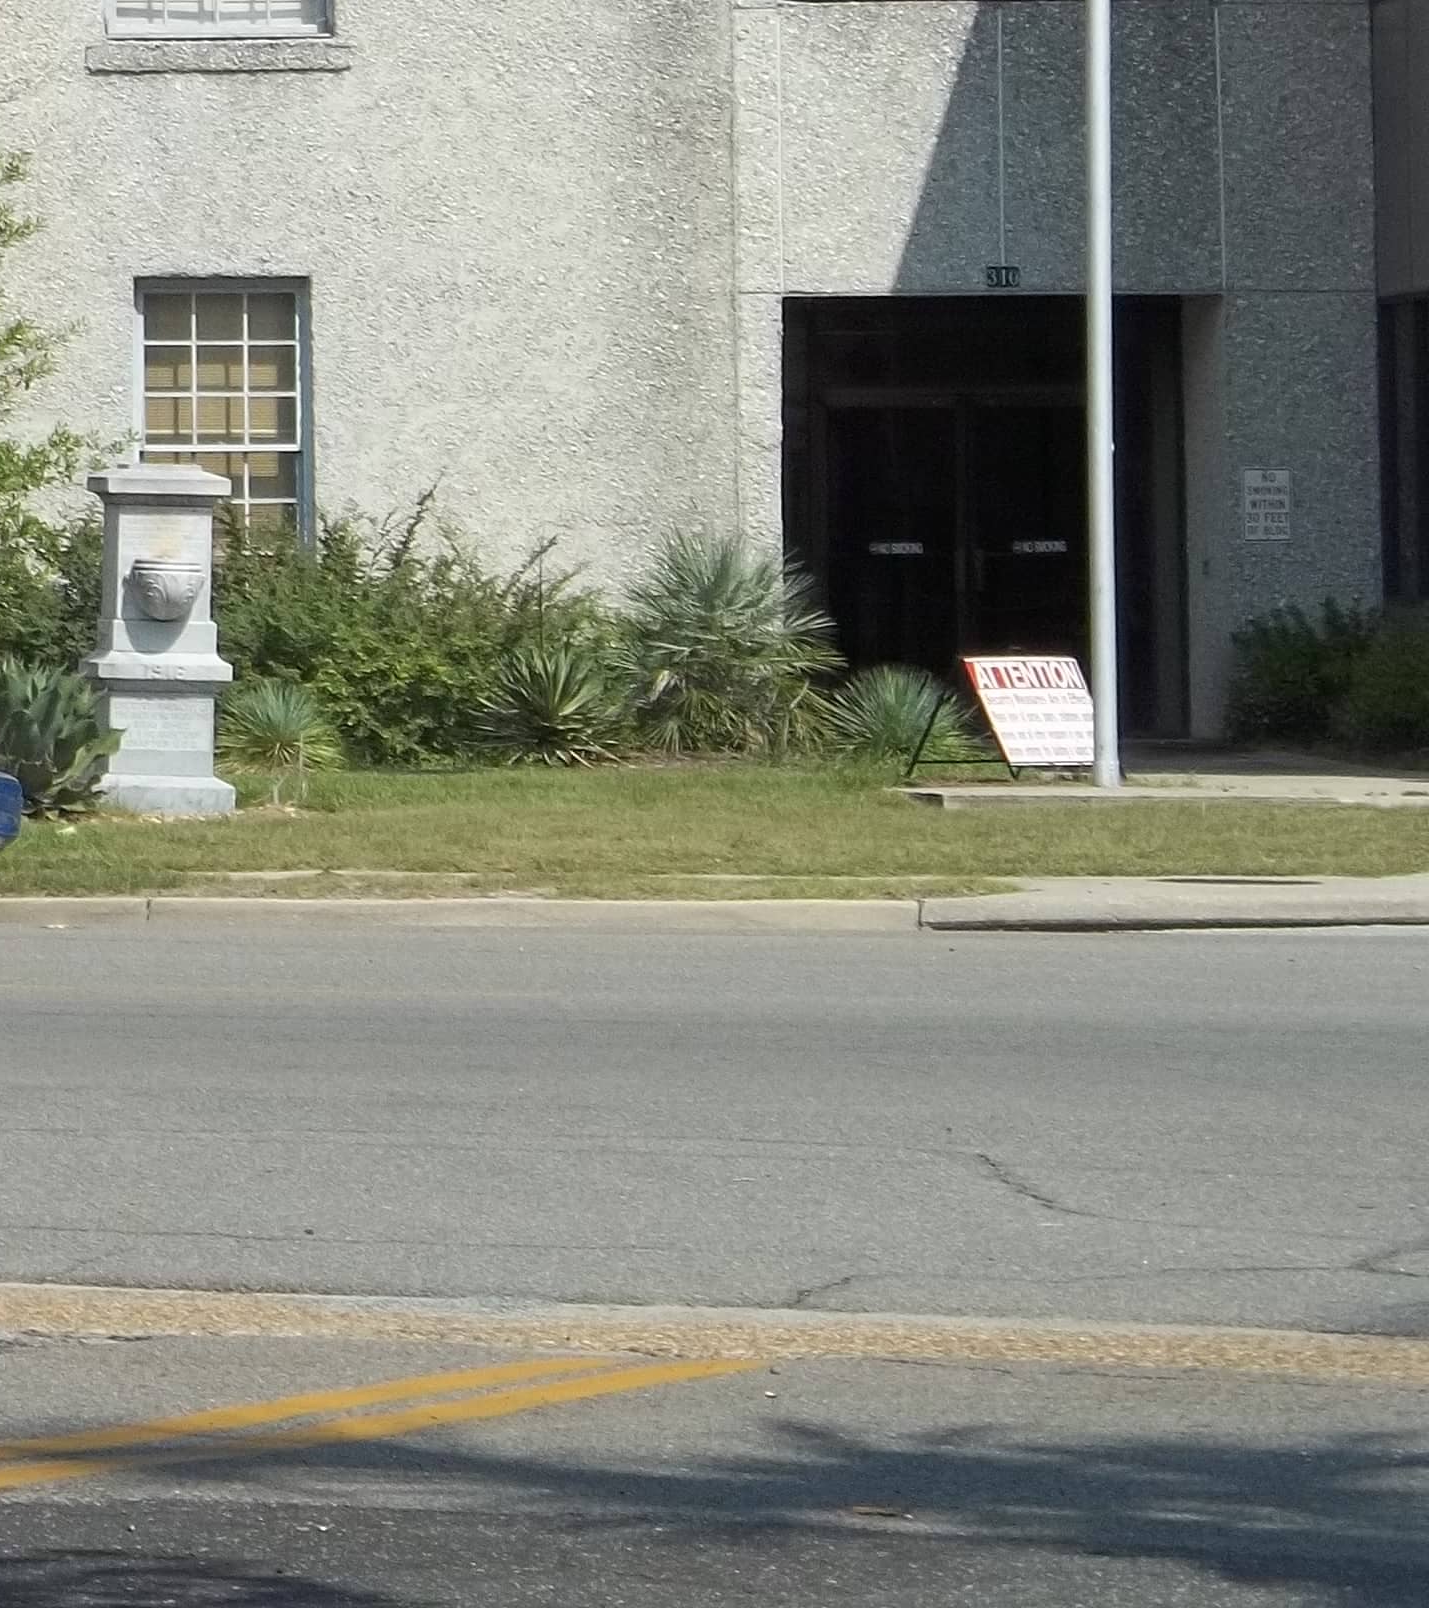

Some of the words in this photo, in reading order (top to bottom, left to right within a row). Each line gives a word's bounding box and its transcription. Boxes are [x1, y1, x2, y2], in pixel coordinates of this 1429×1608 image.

[987, 268, 1019, 286] 310
[1261, 471, 1277, 483] NO
[1264, 512, 1290, 524] FEET
[976, 660, 1086, 689] ATTENTION
